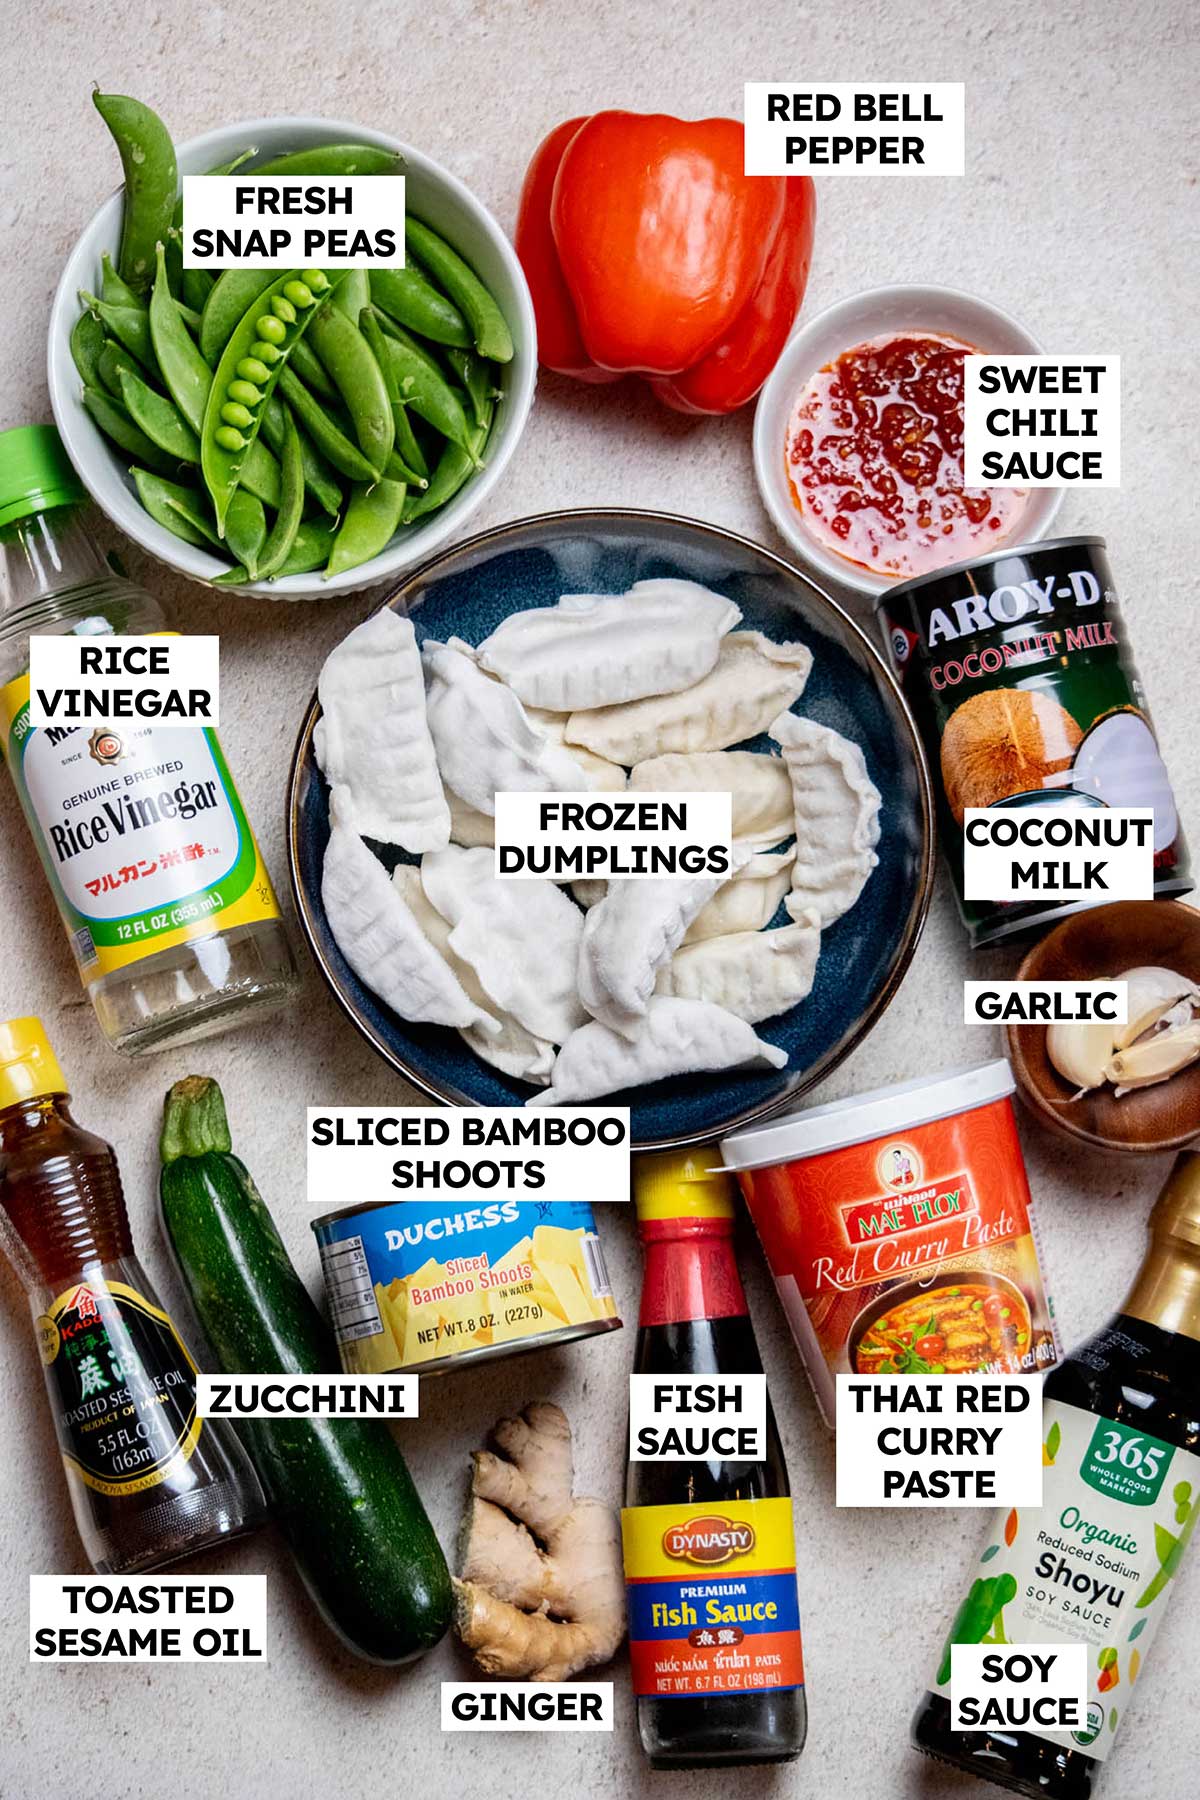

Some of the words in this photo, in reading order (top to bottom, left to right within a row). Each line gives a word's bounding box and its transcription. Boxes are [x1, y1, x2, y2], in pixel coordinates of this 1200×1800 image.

[928, 570, 1100, 647] AROY-D
[929, 631, 1058, 690] COCONUT
[1064, 621, 1119, 651] MILK
[62, 779, 121, 811] GENUINE
[124, 760, 184, 786] BREWED
[49, 815, 109, 863] Rice
[102, 780, 218, 836] Vinegar
[117, 925, 132, 939] 12
[134, 921, 149, 935] FL
[151, 913, 170, 930] OZ
[171, 906, 199, 926] (355
[199, 891, 224, 913] mL)
[384, 1201, 520, 1252] DUCHESS
[858, 1208, 907, 1239] MAE
[912, 1190, 961, 1224] PLOY
[446, 1253, 489, 1277] Sliced
[812, 1247, 865, 1291] Red
[874, 1238, 948, 1288] Curry
[961, 1209, 1014, 1248] Paste
[412, 1278, 474, 1306] Bamboo
[480, 1263, 532, 1289] Shoots
[499, 1290, 509, 1299] IN
[510, 1283, 534, 1297] WATER
[417, 1327, 440, 1345] NET
[480, 1313, 500, 1329] OZ.
[505, 1303, 543, 1326] (227g)
[165, 1370, 186, 1386] OIL
[81, 1411, 118, 1433] PRODUCT
[122, 1405, 136, 1416] OF
[98, 1434, 116, 1456] 5.5
[1094, 1431, 1166, 1480] 365
[1090, 1464, 1121, 1481] WHOLE
[1123, 1477, 1151, 1494] FOODS
[1099, 1478, 1136, 1497] MARKET
[672, 1531, 748, 1550] DYNASTY
[1059, 1506, 1138, 1554] Organic
[1037, 1530, 1094, 1561] Reduced
[1095, 1554, 1140, 1581] Sodium
[680, 1584, 747, 1598] PREMIUM
[1035, 1552, 1125, 1608] Shoyu
[651, 1601, 698, 1628] Fish
[705, 1599, 778, 1624] Sauce
[1026, 1586, 1057, 1605] SOY
[1061, 1600, 1112, 1628] SAUCE
[755, 1654, 782, 1668] PATIS
[657, 1678, 672, 1691] NET
[674, 1677, 692, 1691] WT.
[695, 1676, 710, 1690] 6.7
[713, 1675, 725, 1688] FL
[727, 1674, 740, 1687] OZ
